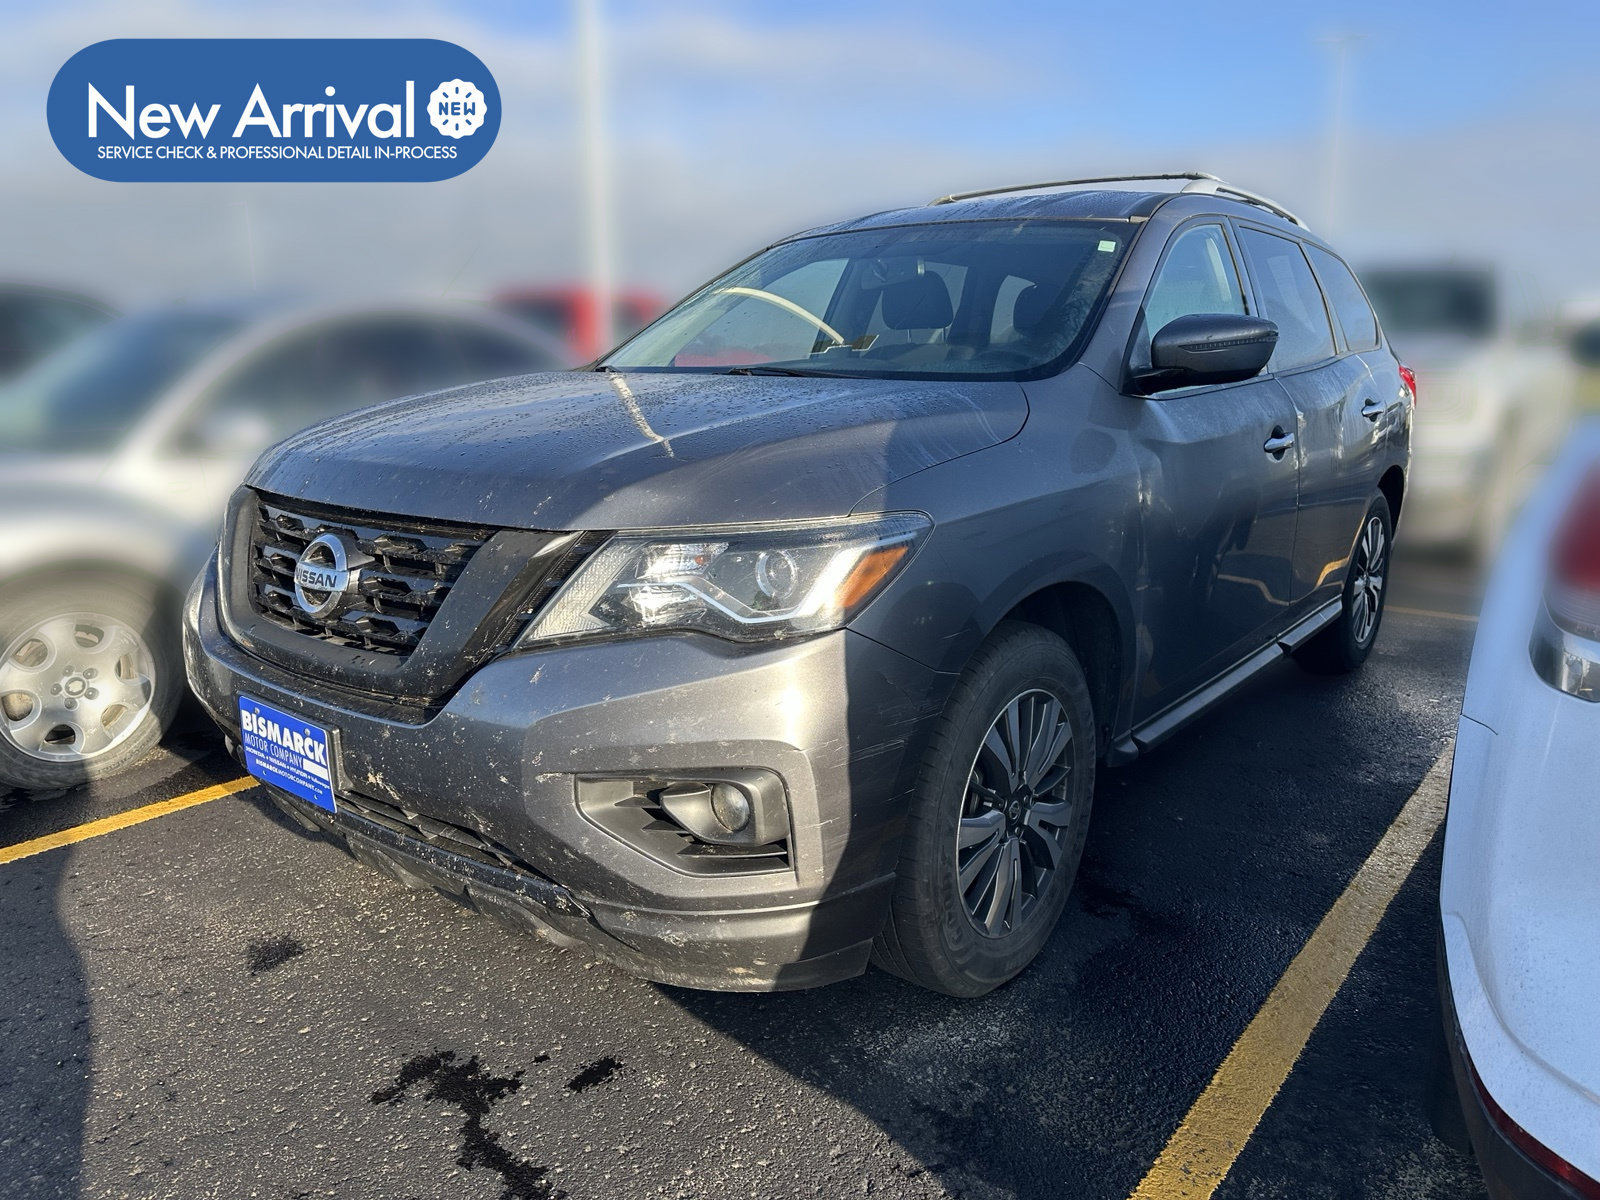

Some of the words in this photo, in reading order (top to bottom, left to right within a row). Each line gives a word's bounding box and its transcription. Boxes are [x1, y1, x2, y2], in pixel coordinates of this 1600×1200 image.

[295, 568, 338, 588] NISSAN
[240, 709, 327, 766] BISMARCK
[244, 732, 269, 753] MOTOR
[270, 743, 303, 769] COMPANY
